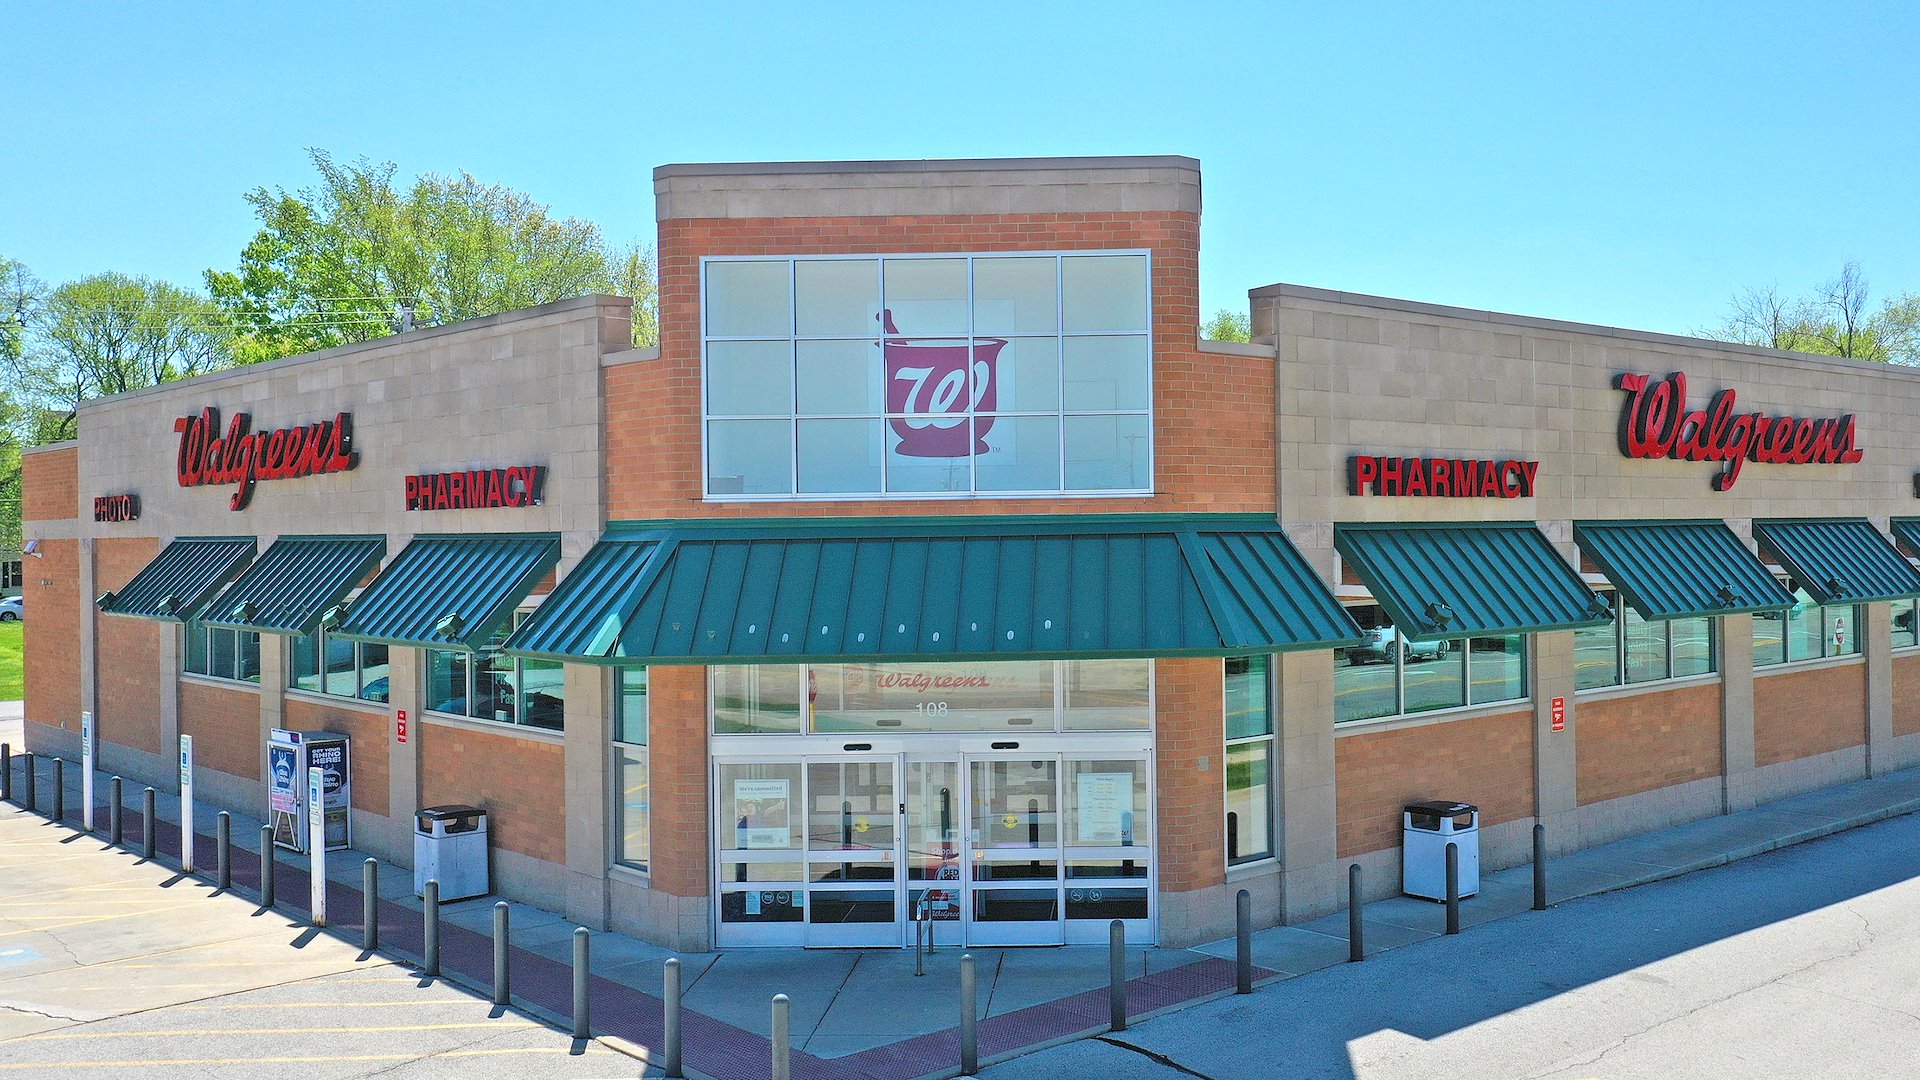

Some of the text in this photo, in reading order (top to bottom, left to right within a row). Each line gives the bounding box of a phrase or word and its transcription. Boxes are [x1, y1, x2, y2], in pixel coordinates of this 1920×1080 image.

[1620, 371, 1864, 491] Walgreens
[174, 406, 355, 511] Walgreens
[405, 466, 539, 511] PHARMACY
[1355, 455, 1540, 499] PHARMACY
[93, 495, 132, 522] PHOTO
[877, 672, 990, 693] Walgreens
[915, 701, 949, 718] 108
[312, 751, 341, 759] RHINO
[313, 757, 341, 765] HERE!
